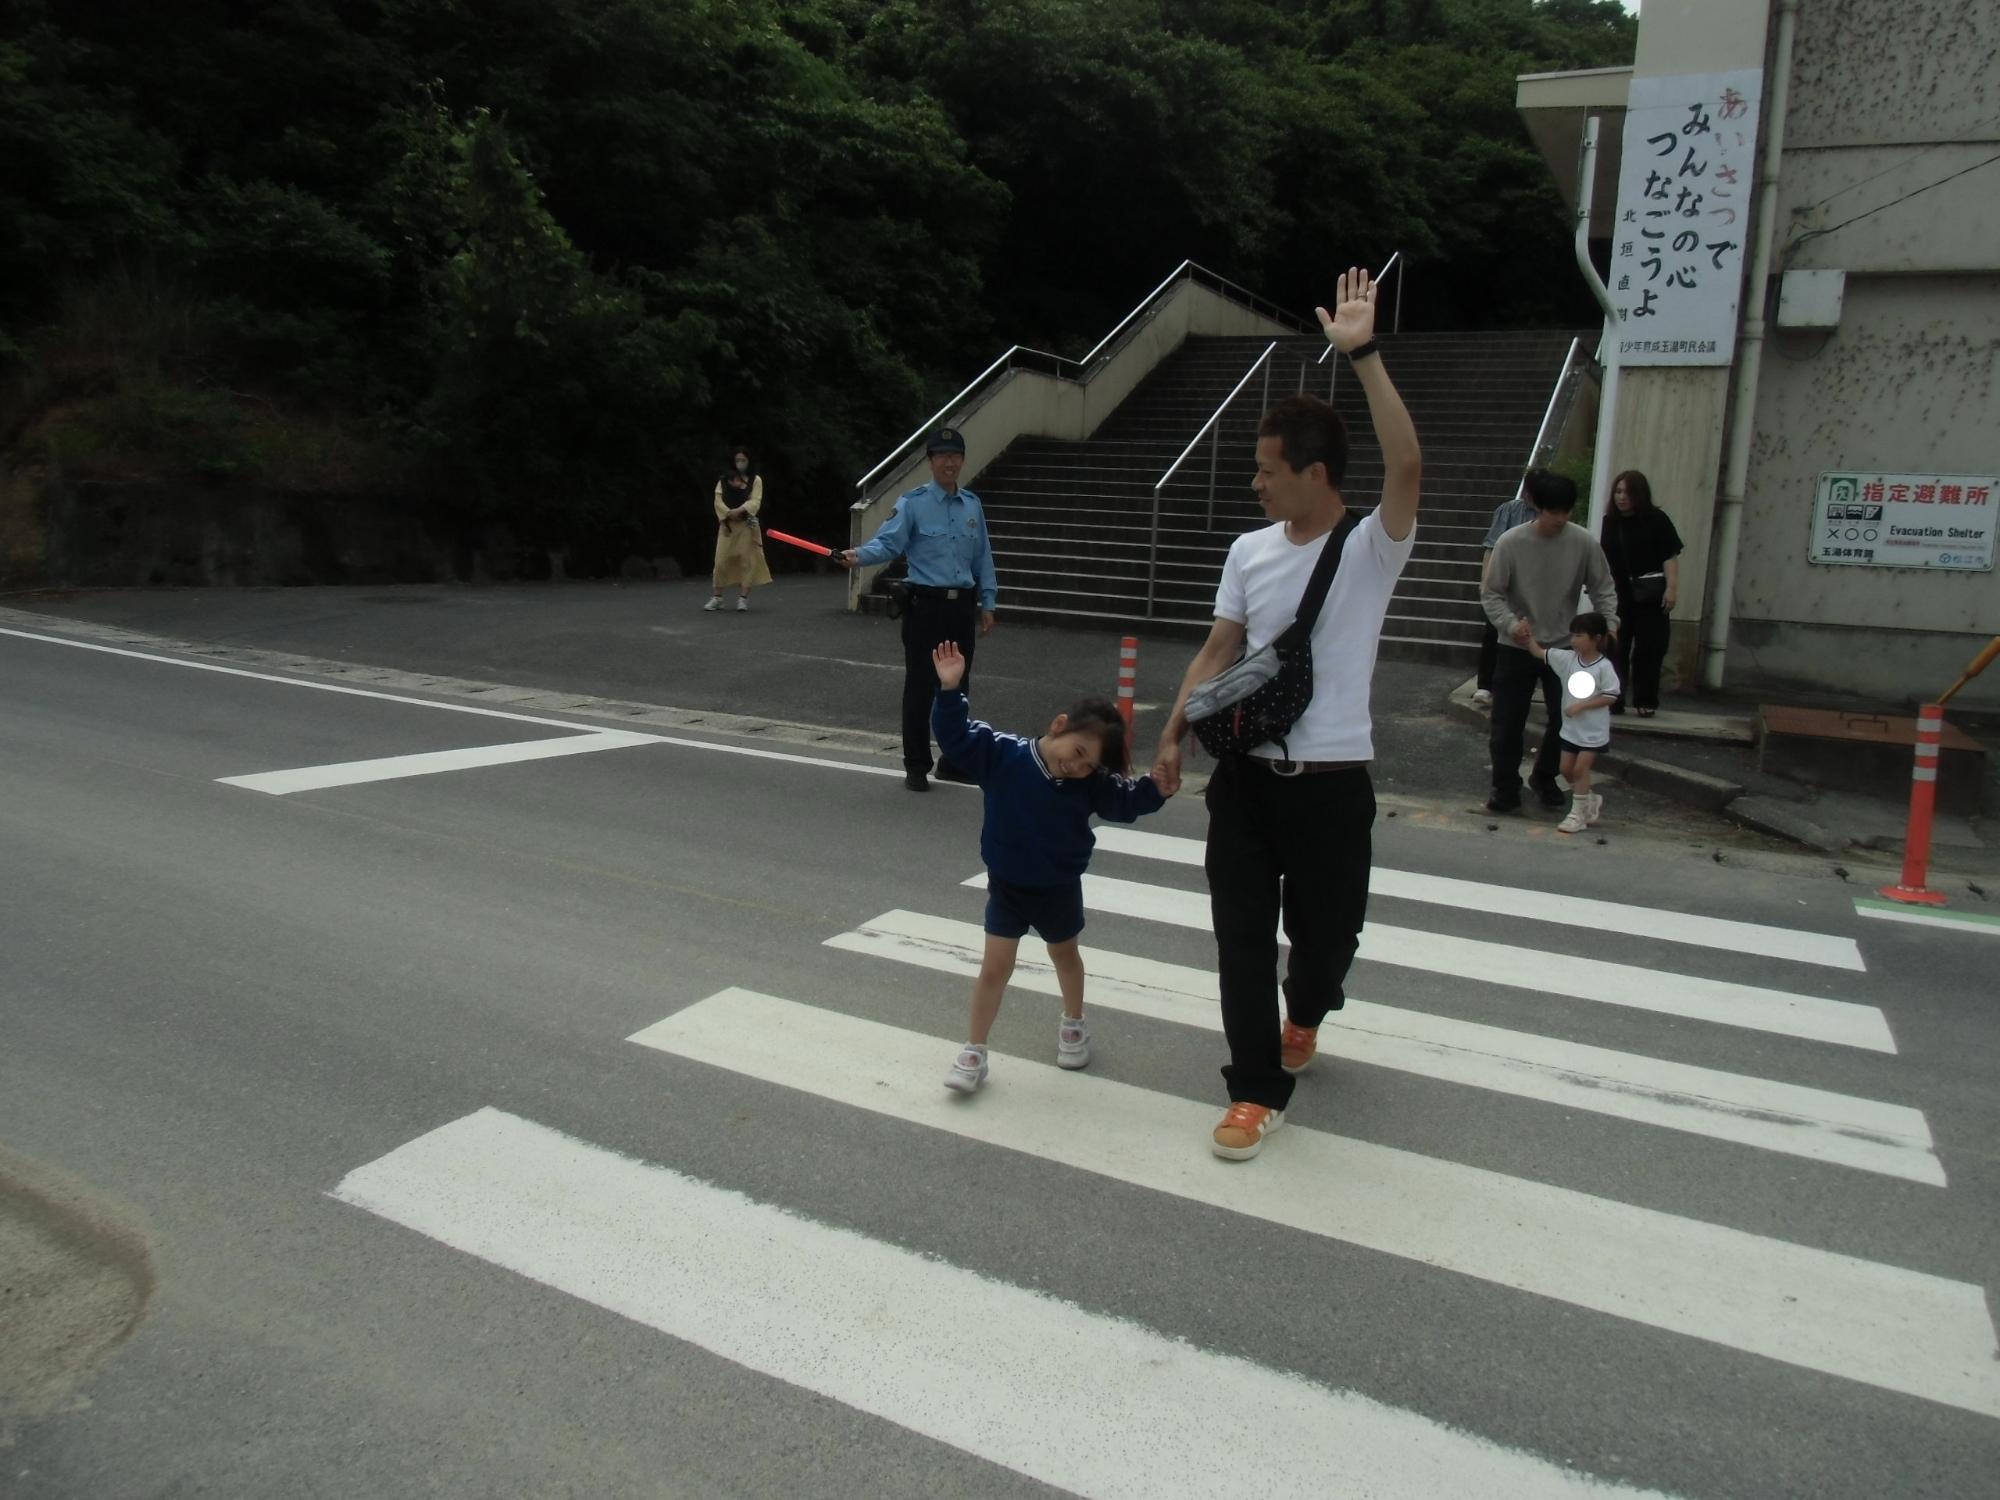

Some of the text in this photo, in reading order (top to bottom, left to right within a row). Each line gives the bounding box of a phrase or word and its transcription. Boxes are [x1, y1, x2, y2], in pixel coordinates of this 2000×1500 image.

[1633, 131, 1678, 317] つなごうよ
[1666, 103, 1711, 289] みんなの心
[1705, 87, 1749, 270] あいさつで
[1862, 482, 1990, 506] 指定避難所
[1889, 525, 1985, 539] Evacuation Shelter
